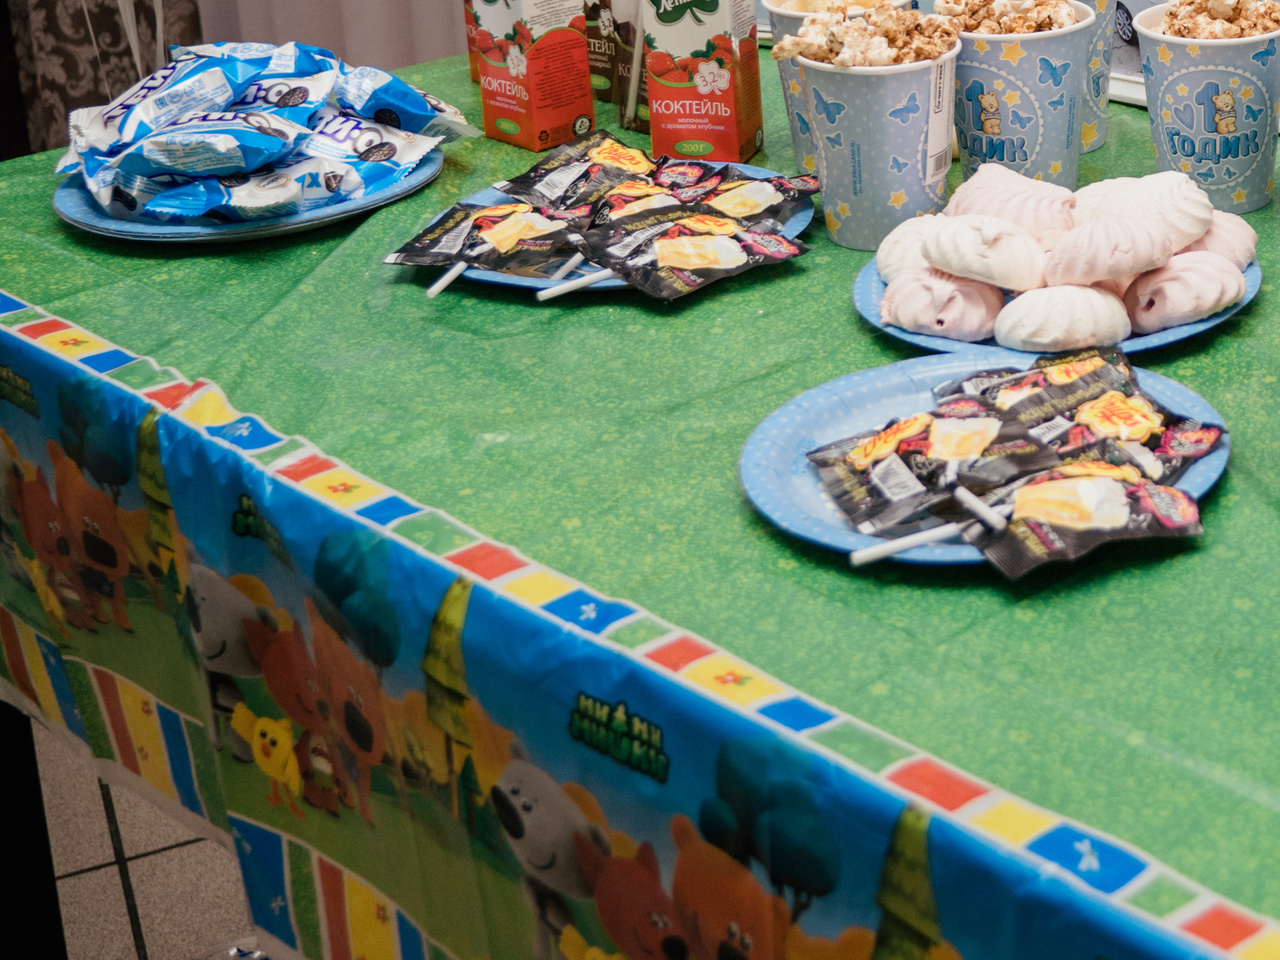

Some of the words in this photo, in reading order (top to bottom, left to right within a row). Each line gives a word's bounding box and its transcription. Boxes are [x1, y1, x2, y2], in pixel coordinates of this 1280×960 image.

[480, 74, 530, 101] КОКТЕЙЛЬ
[652, 99, 731, 117] КОКТЕЙЛЬ
[1164, 127, 1260, 165] ГОДИК
